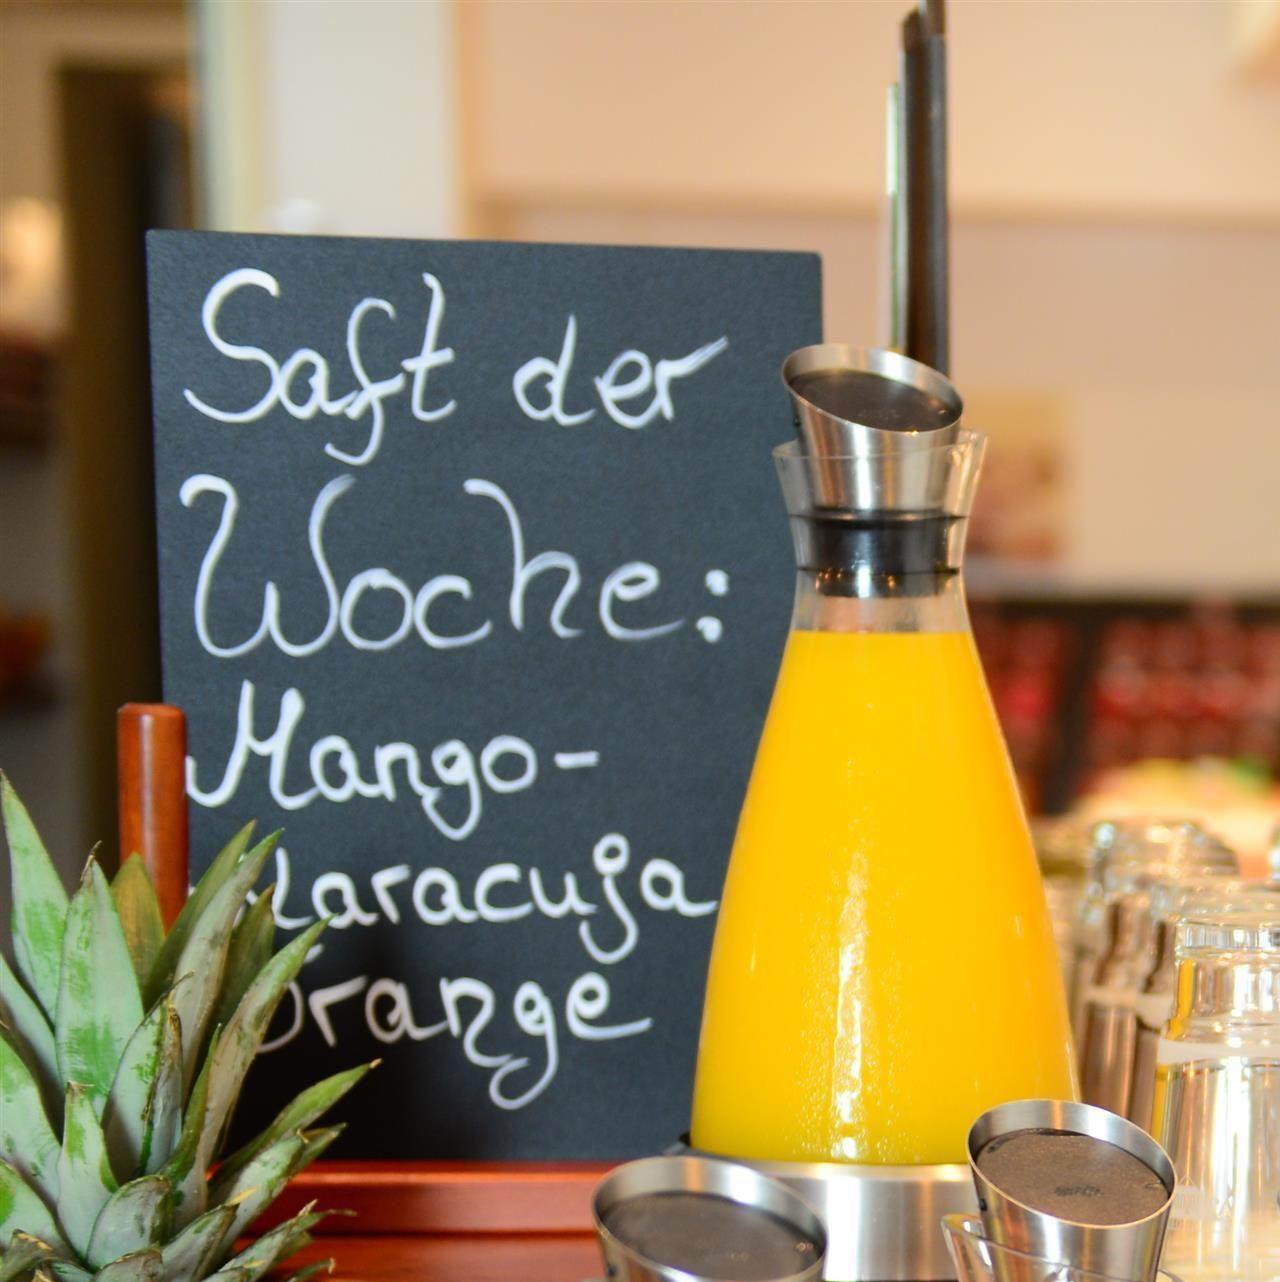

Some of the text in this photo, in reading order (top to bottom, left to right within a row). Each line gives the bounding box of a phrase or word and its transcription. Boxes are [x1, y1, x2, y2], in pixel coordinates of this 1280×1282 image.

[184, 267, 728, 464] Saft der
[180, 472, 729, 658] Woche:
[186, 680, 600, 840] Mango-
